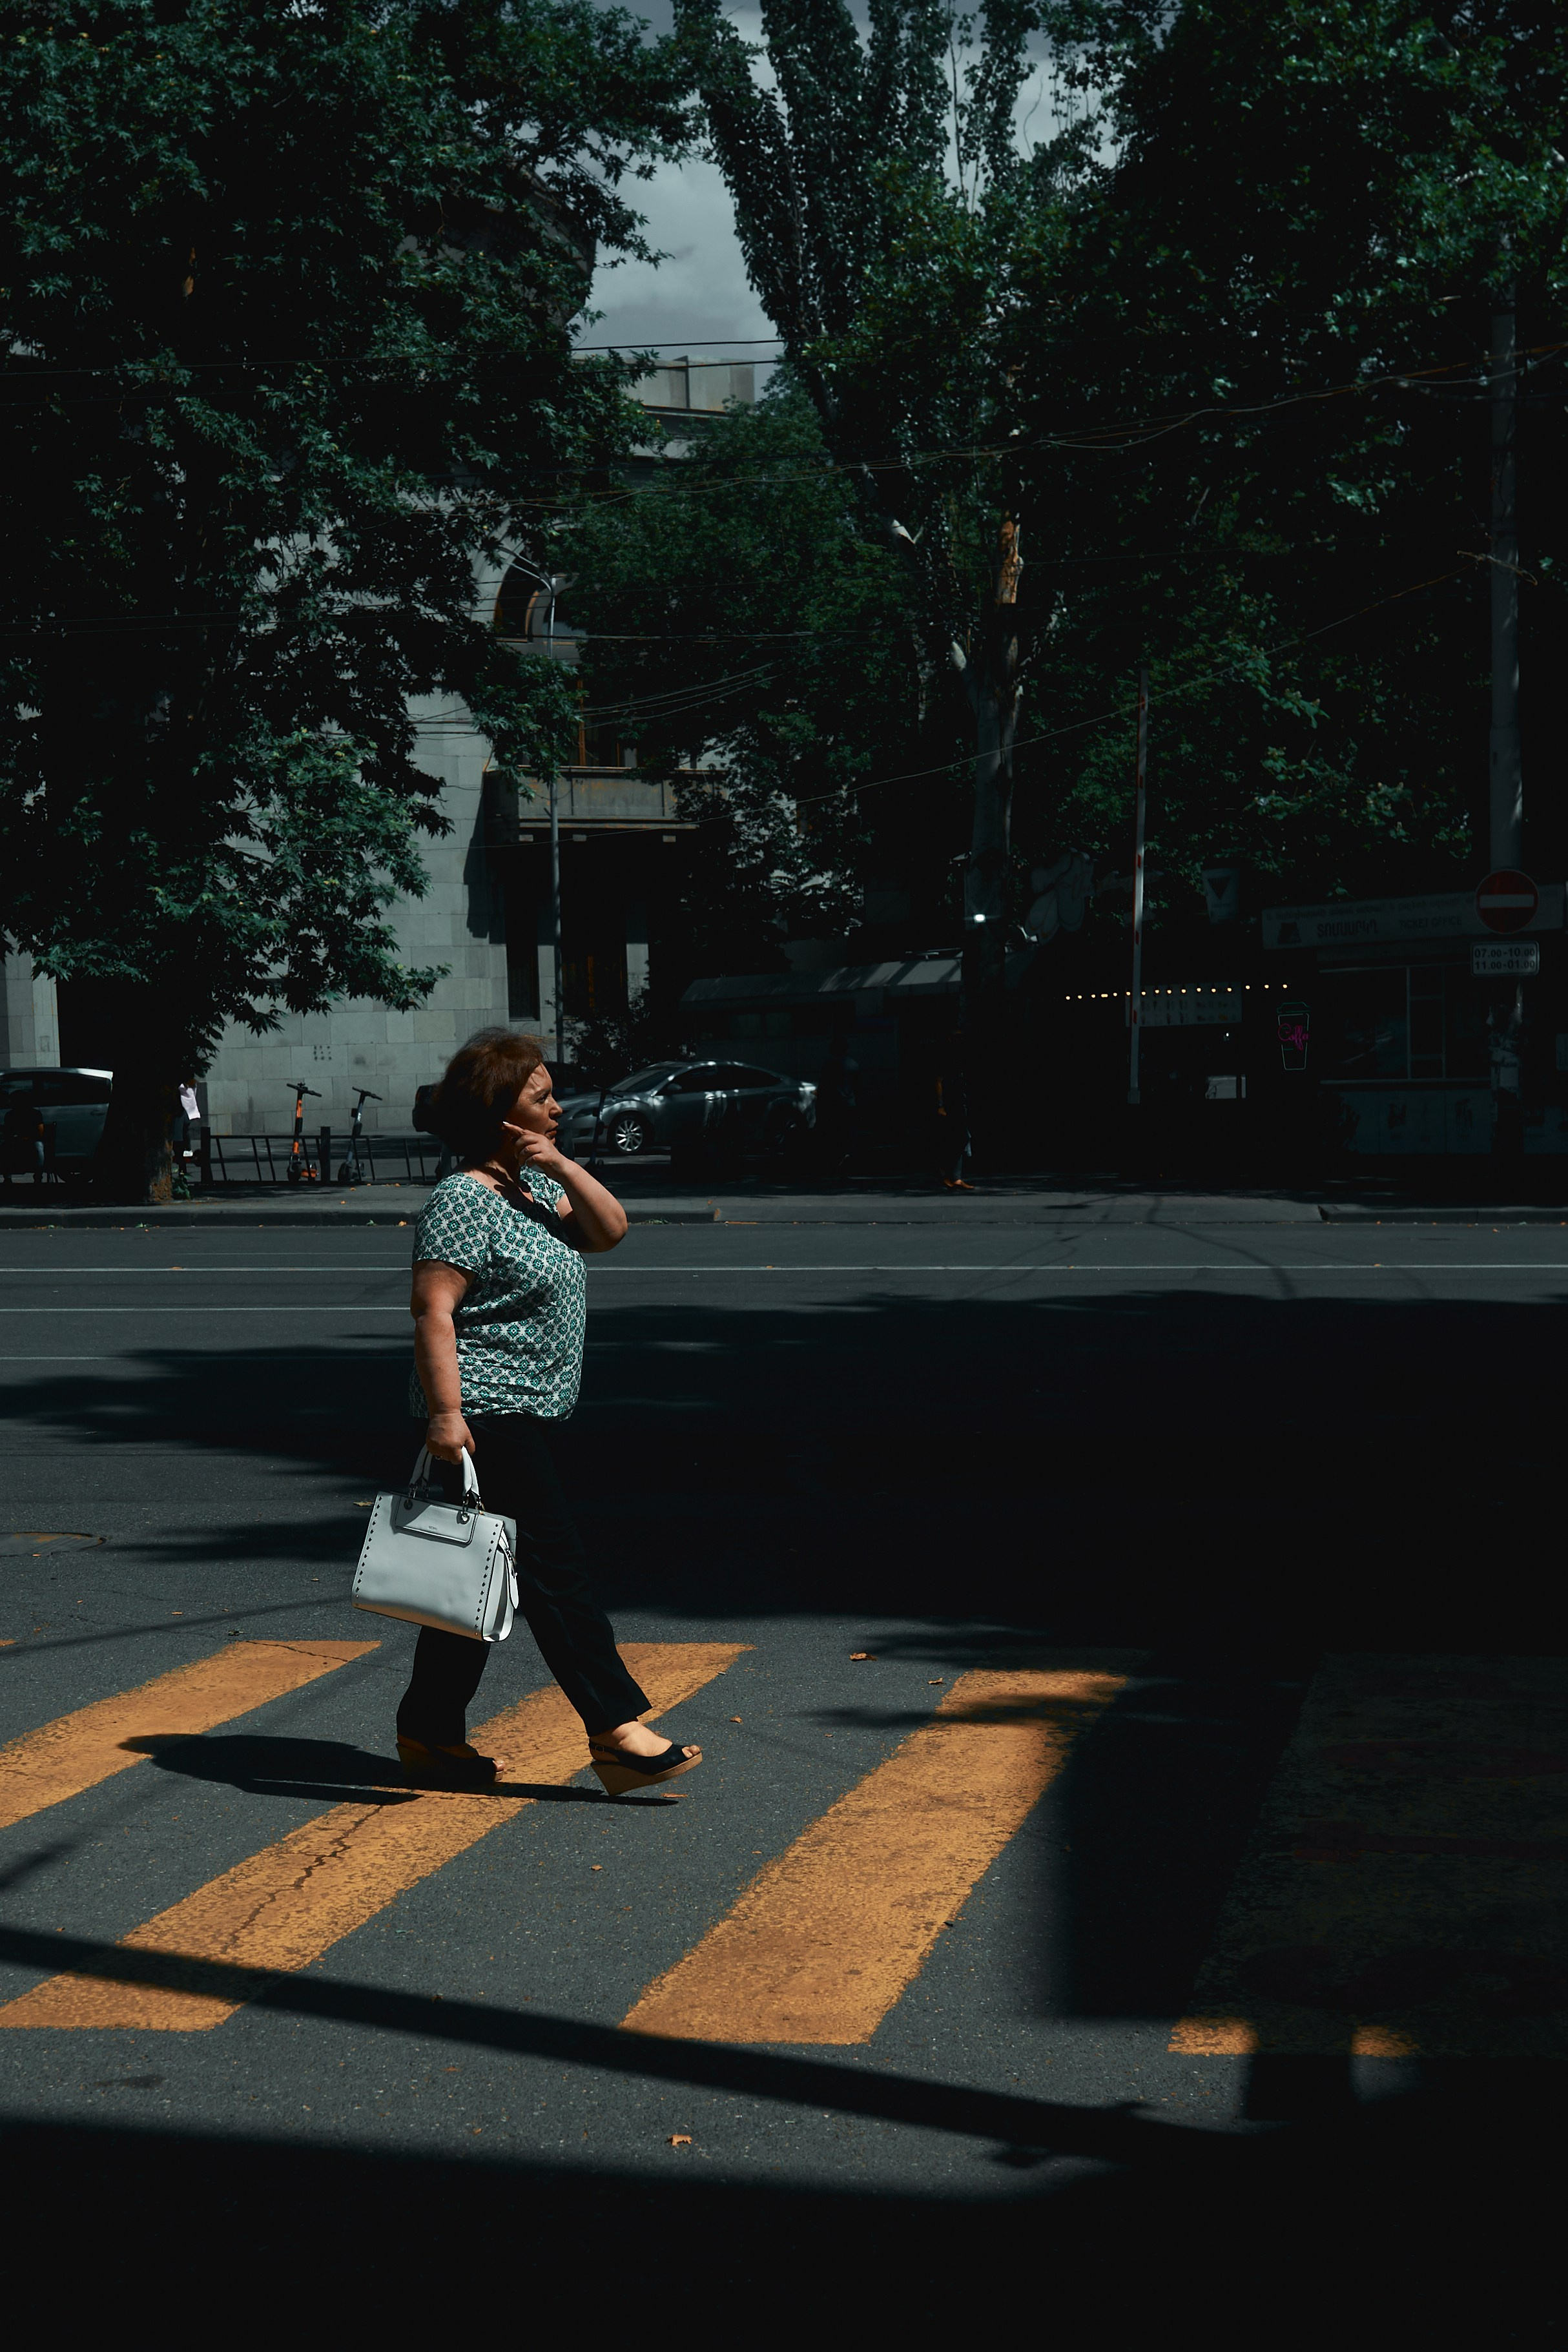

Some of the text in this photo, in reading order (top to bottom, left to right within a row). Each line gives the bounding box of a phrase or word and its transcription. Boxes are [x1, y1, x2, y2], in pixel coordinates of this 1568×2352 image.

[1398, 915, 1462, 930] TICKET OFFICE
[1474, 947, 1534, 958] 07.00-10.00
[1475, 960, 1534, 969] 11.00-01.00
